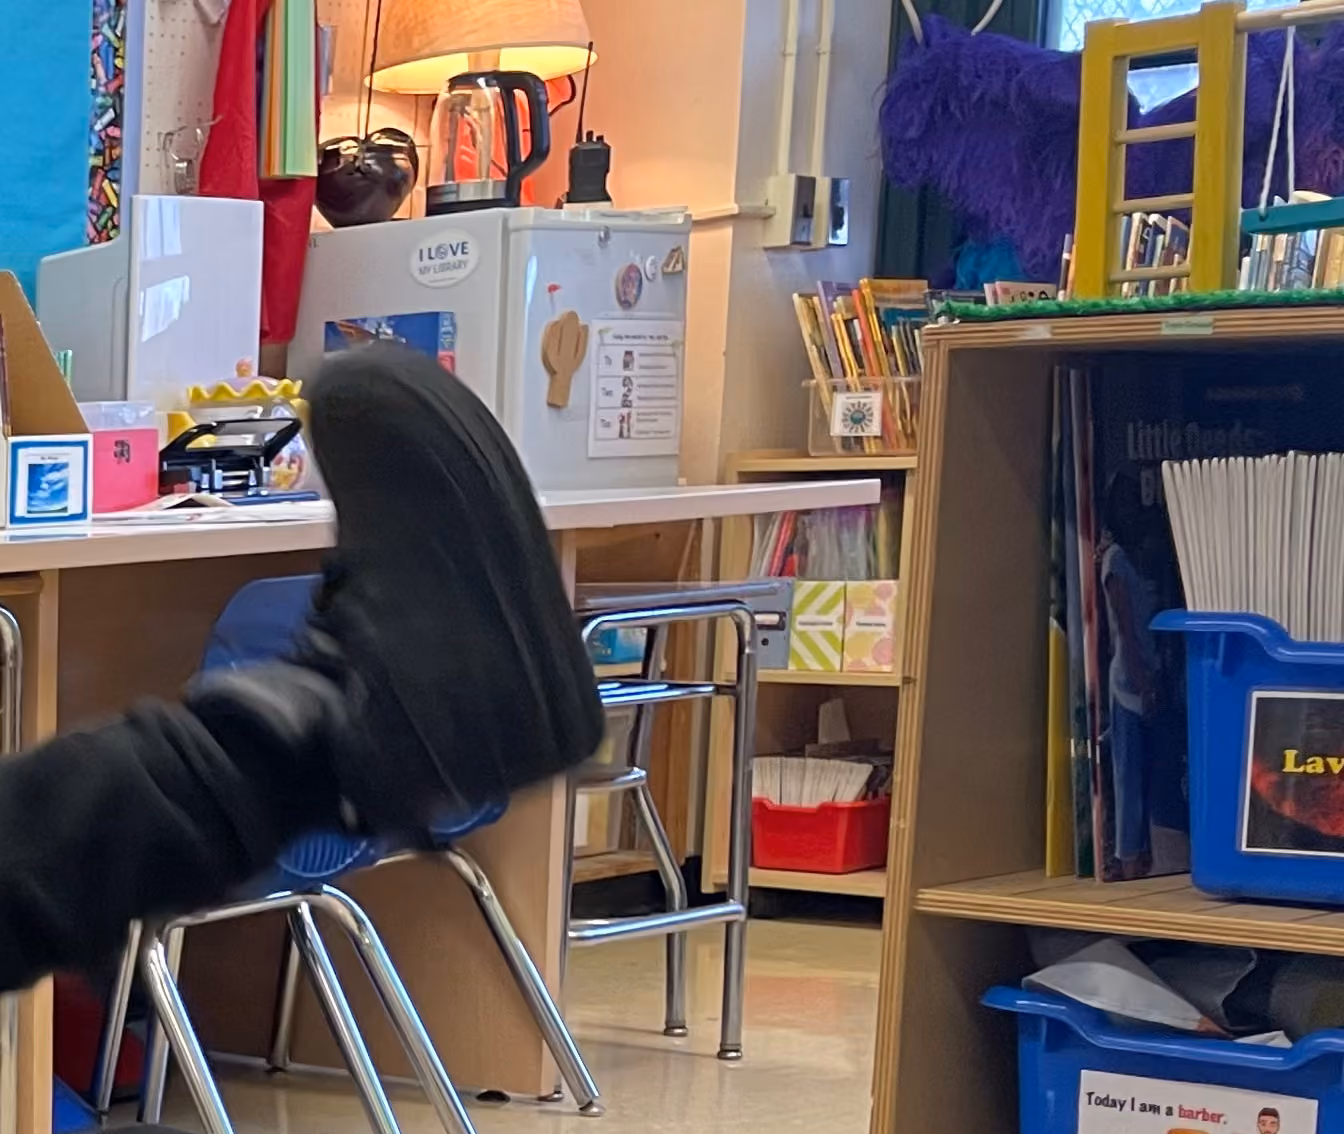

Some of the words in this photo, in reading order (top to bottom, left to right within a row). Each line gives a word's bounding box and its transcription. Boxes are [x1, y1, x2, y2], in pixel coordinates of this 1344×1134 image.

[1086, 1091, 1126, 1112] Today
[1131, 1097, 1135, 1111] I
[1139, 1102, 1161, 1115] am
[1165, 1106, 1174, 1116] a
[1178, 1104, 1227, 1125] barber.
